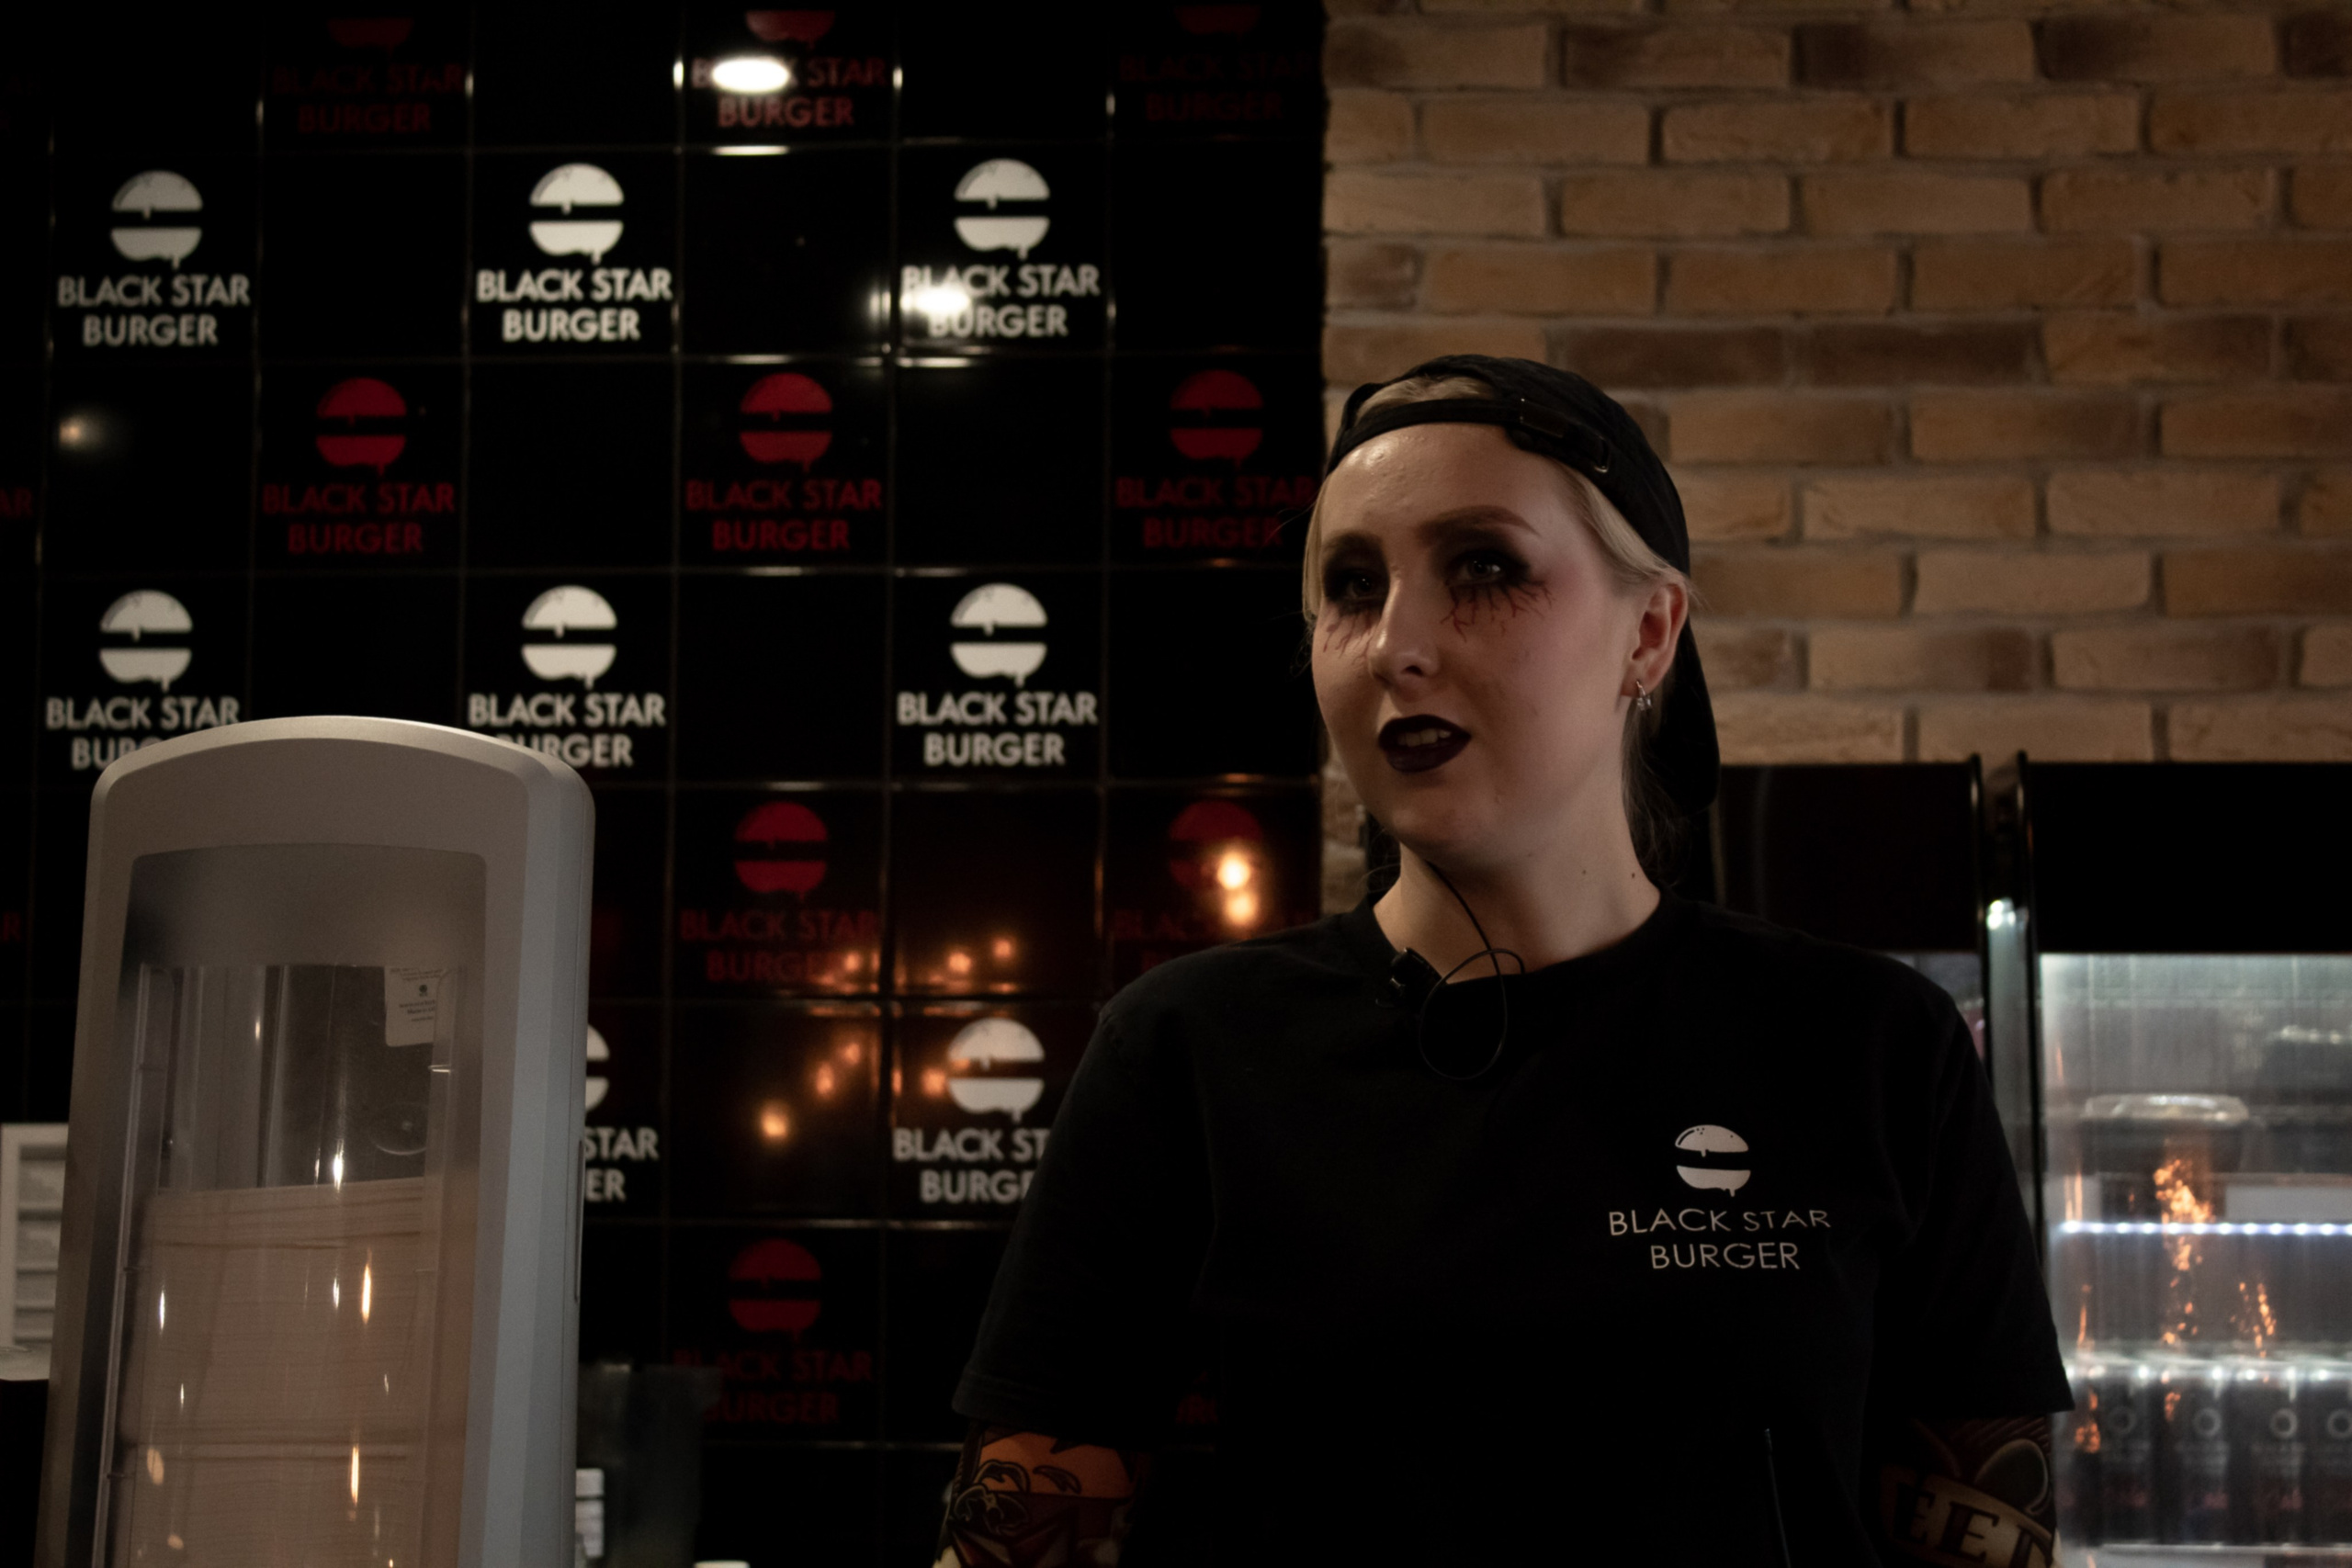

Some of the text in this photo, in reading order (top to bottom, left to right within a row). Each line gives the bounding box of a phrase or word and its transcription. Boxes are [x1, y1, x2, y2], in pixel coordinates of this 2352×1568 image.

[805, 57, 888, 88] STAR
[717, 95, 855, 128] BURGER
[57, 274, 250, 308] BLACK STAR
[476, 267, 673, 302] BLACK STAR
[1016, 264, 1101, 297] STAR
[83, 313, 219, 347] BURGER
[502, 308, 641, 343] BURGER
[262, 481, 457, 515] BLACK STAR
[685, 478, 883, 512] BLACK STAR
[1114, 476, 1226, 509] BLACK
[288, 522, 424, 555] BURGER
[712, 519, 851, 552] BURGER
[1142, 517, 1283, 549] BURGER
[45, 694, 241, 731] BLACK STAR
[468, 692, 667, 728] BLACK STAR
[897, 691, 1098, 726] BLACK STAR
[923, 732, 1066, 766] BURGER
[892, 1126, 1004, 1163] BLACK
[1608, 1208, 1832, 1236] BLACK STAR
[1650, 1241, 1802, 1270] BURGER
[791, 1350, 875, 1382] STAR
